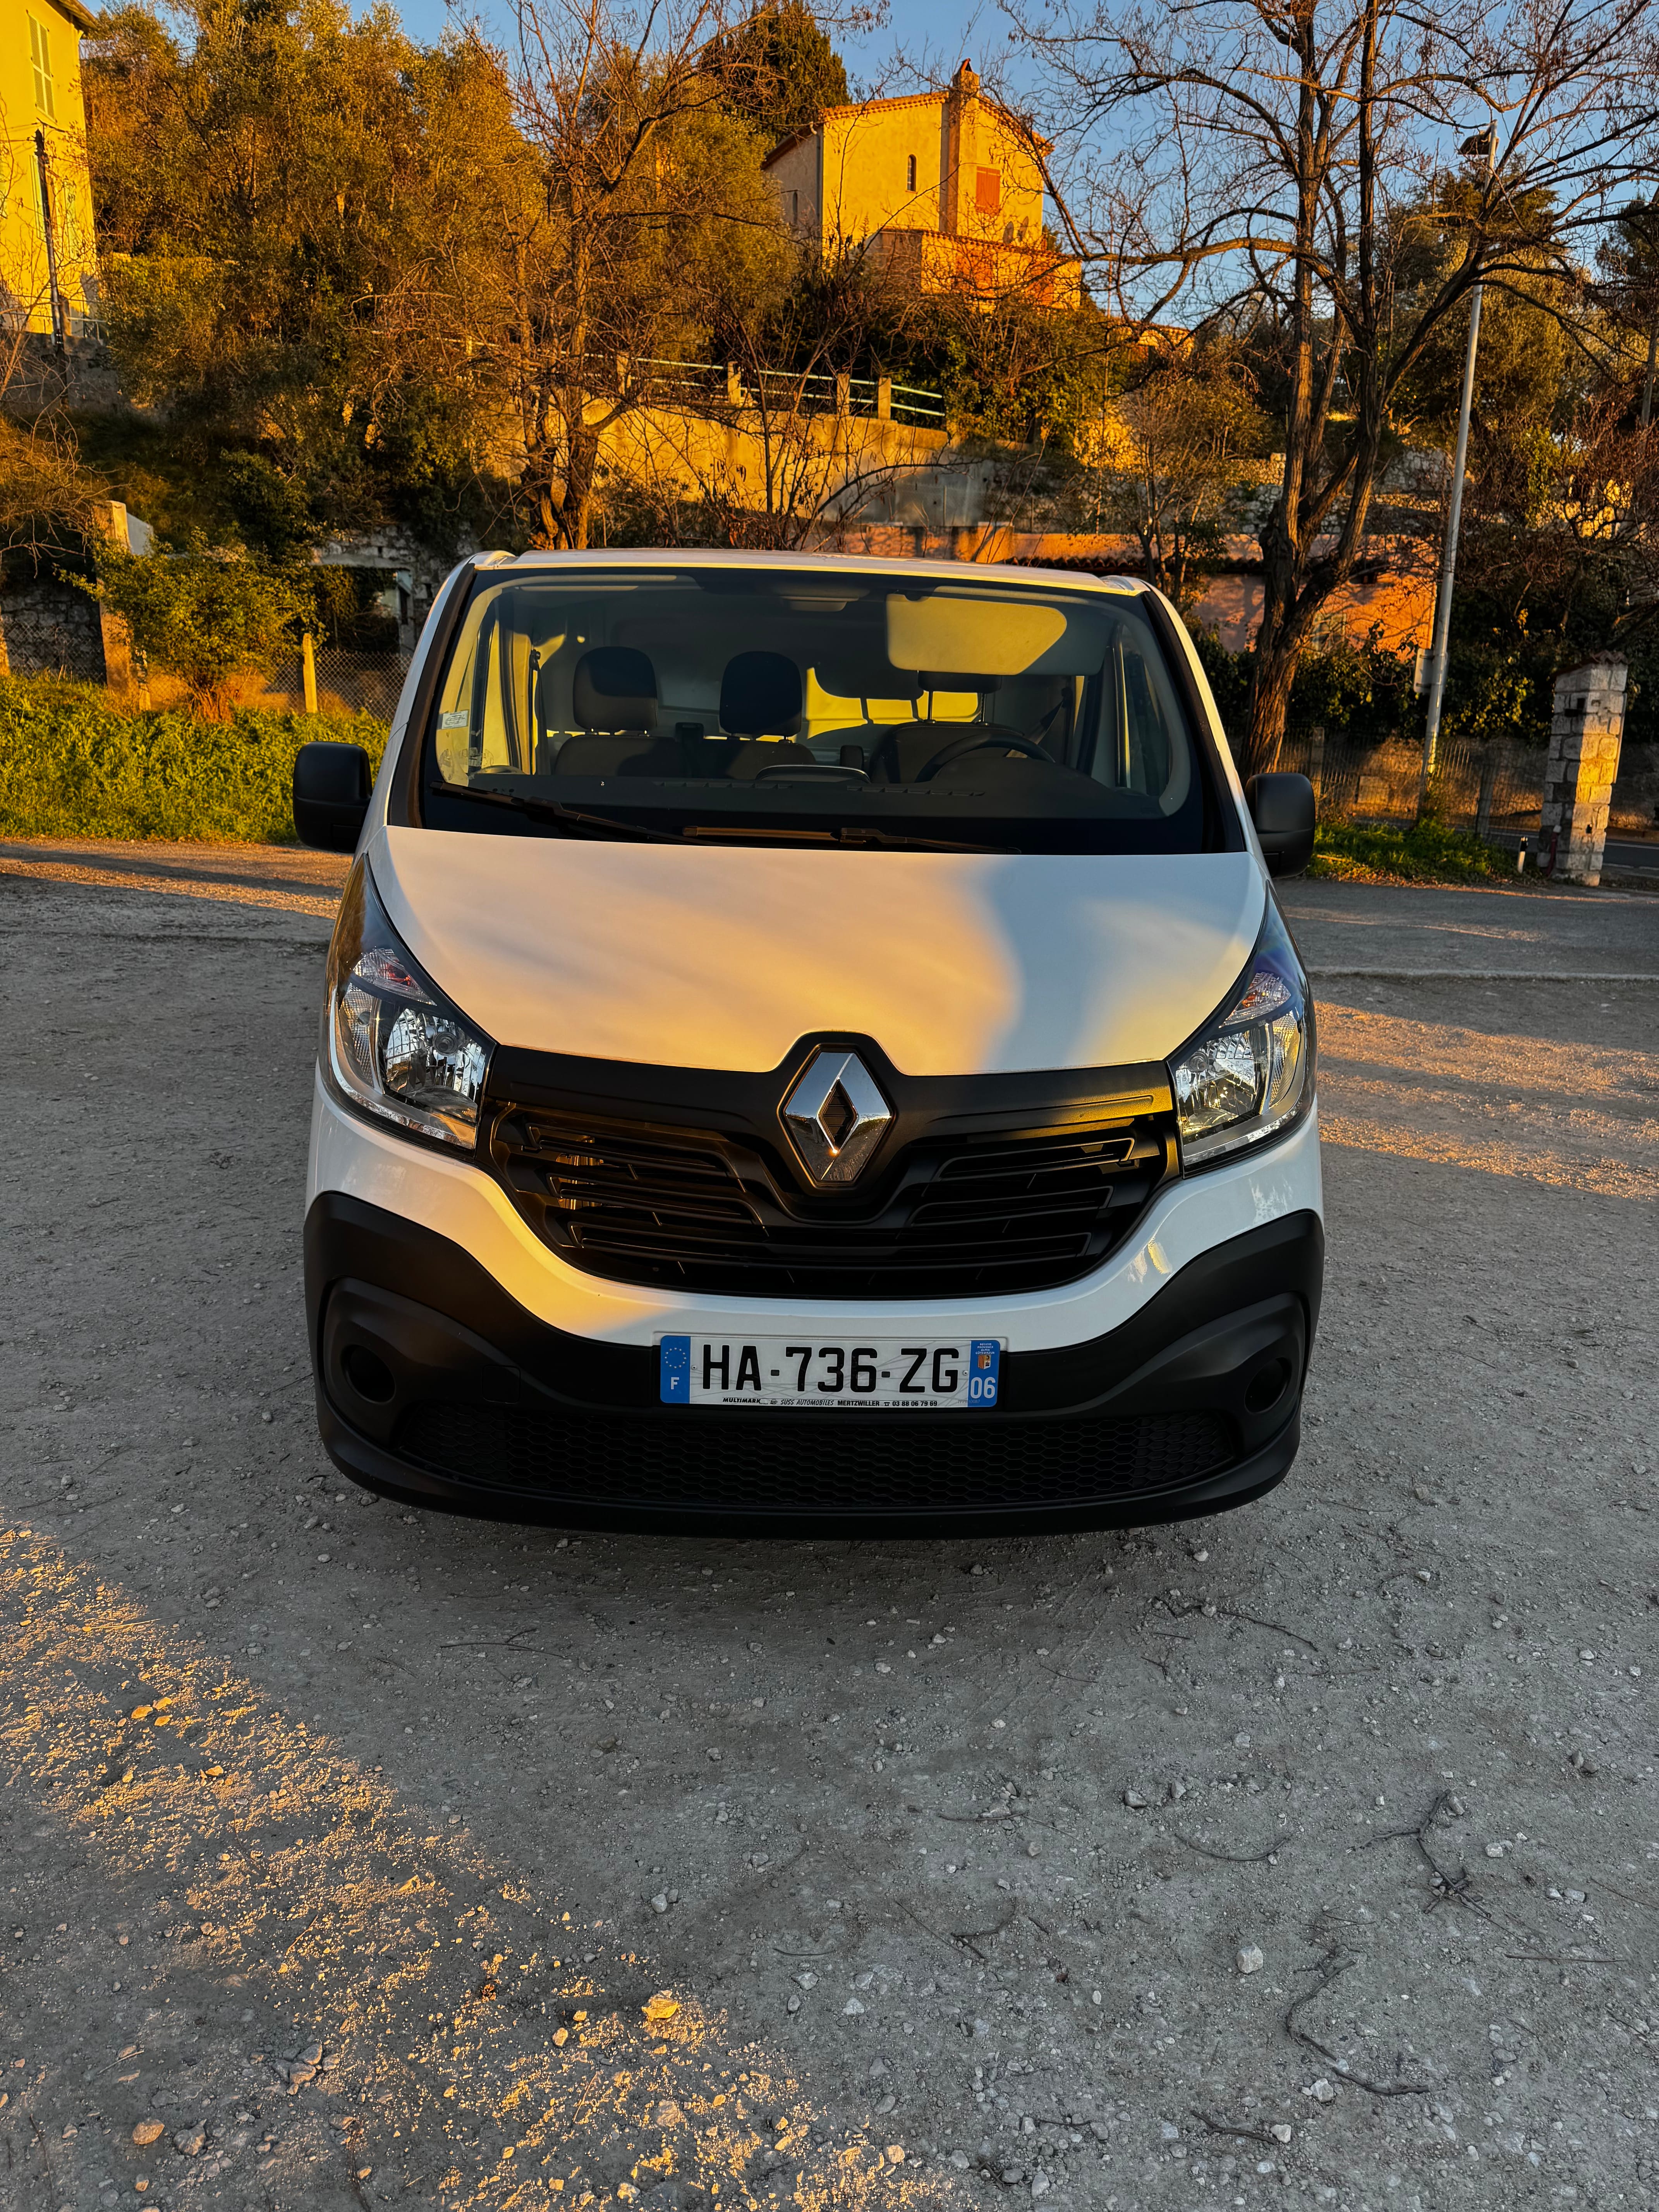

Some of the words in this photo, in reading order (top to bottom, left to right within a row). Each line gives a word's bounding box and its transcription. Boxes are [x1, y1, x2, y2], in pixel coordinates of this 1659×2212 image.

[702, 1344, 959, 1393] HA-736-ZG
[671, 1377, 679, 1389] F
[970, 1377, 996, 1399] 06
